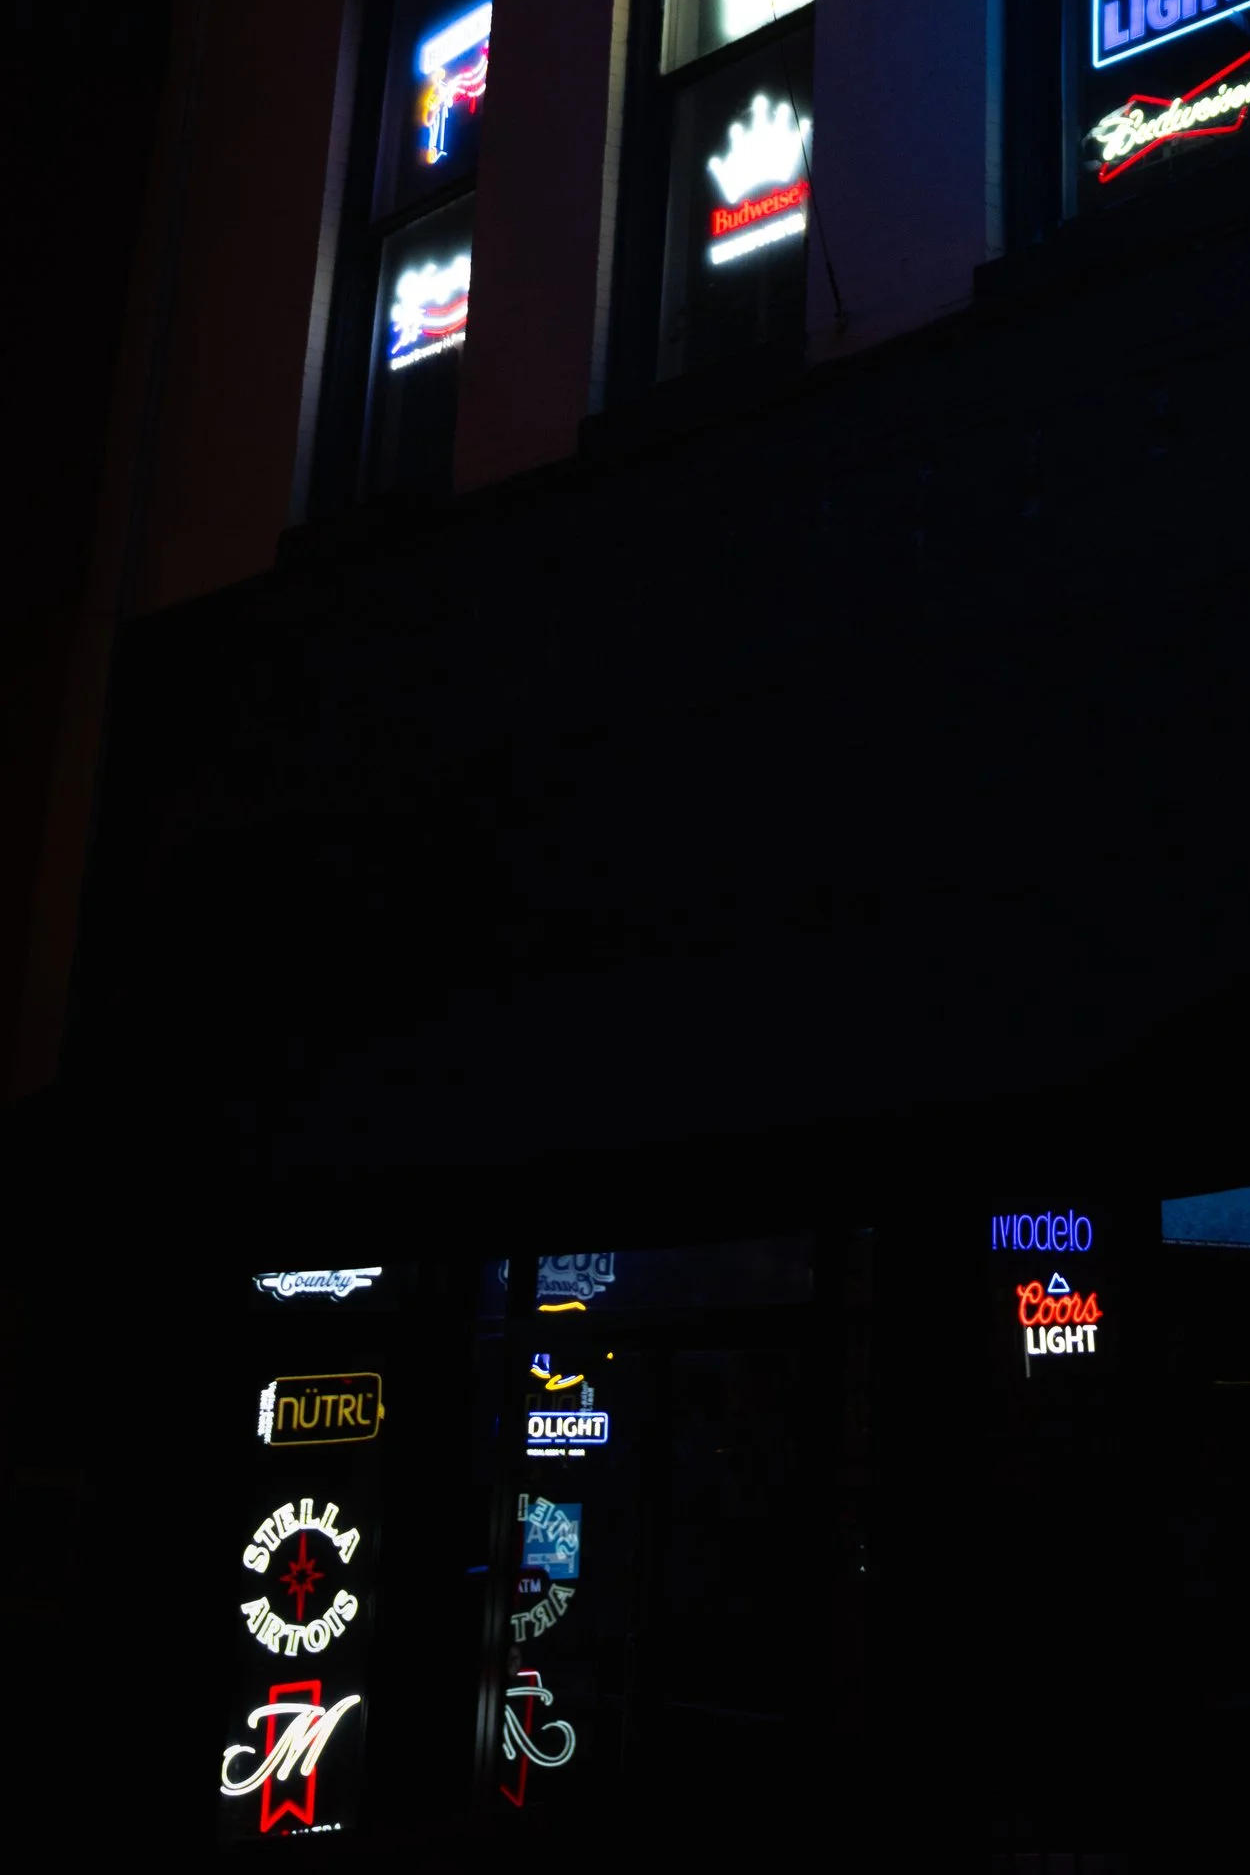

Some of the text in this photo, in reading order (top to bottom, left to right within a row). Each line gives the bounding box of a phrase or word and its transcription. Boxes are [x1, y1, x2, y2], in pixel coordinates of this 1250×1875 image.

[713, 181, 809, 236] Budweiser
[991, 1209, 1092, 1252] Modelo
[1016, 1280, 1103, 1325] Coors
[1026, 1324, 1098, 1355] LIGHT
[242, 1498, 361, 1573] STELLA
[240, 1589, 359, 1656] ARTOIS
